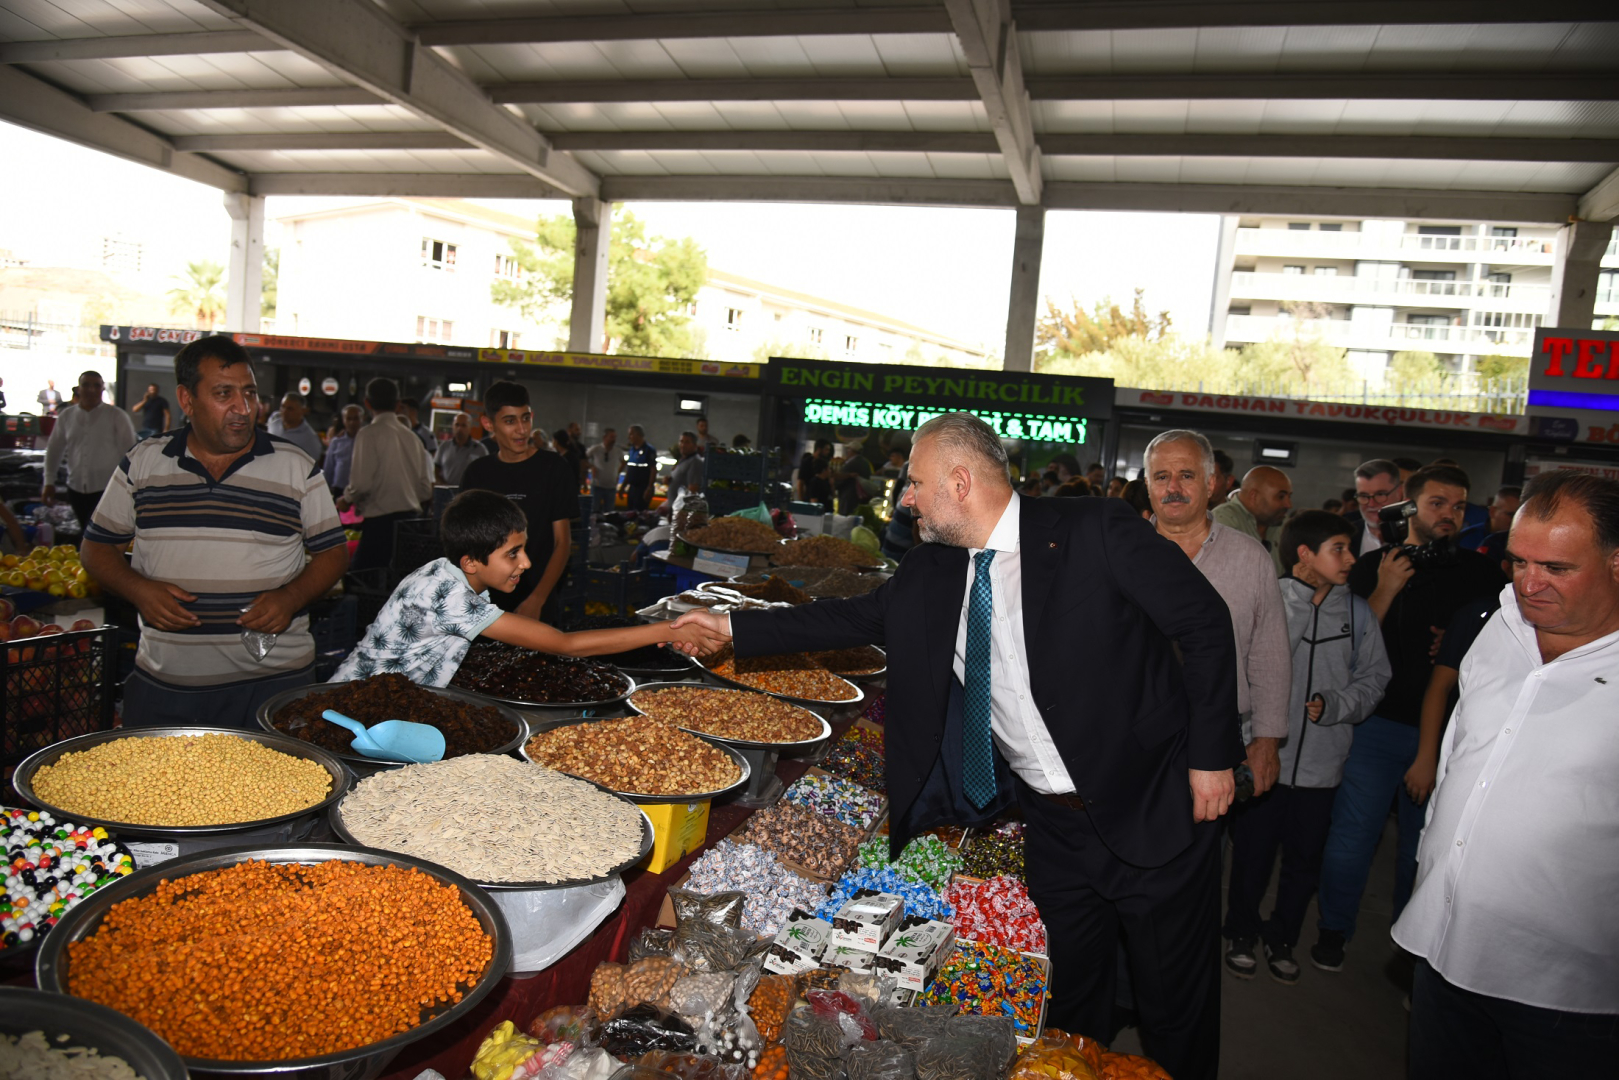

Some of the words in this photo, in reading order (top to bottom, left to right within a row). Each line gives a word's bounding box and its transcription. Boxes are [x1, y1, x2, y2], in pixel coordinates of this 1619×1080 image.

[571, 356, 653, 369] TAVUKÇULUK
[780, 367, 876, 391] ENGİN
[883, 374, 1086, 405] PEYNİRCİLİK
[872, 405, 915, 428] KÖY
[1006, 418, 1024, 436] &
[1027, 420, 1072, 440] TAM
[1181, 394, 1286, 413] DAĞHAN
[1293, 402, 1471, 426] TAVUKÇULUK
